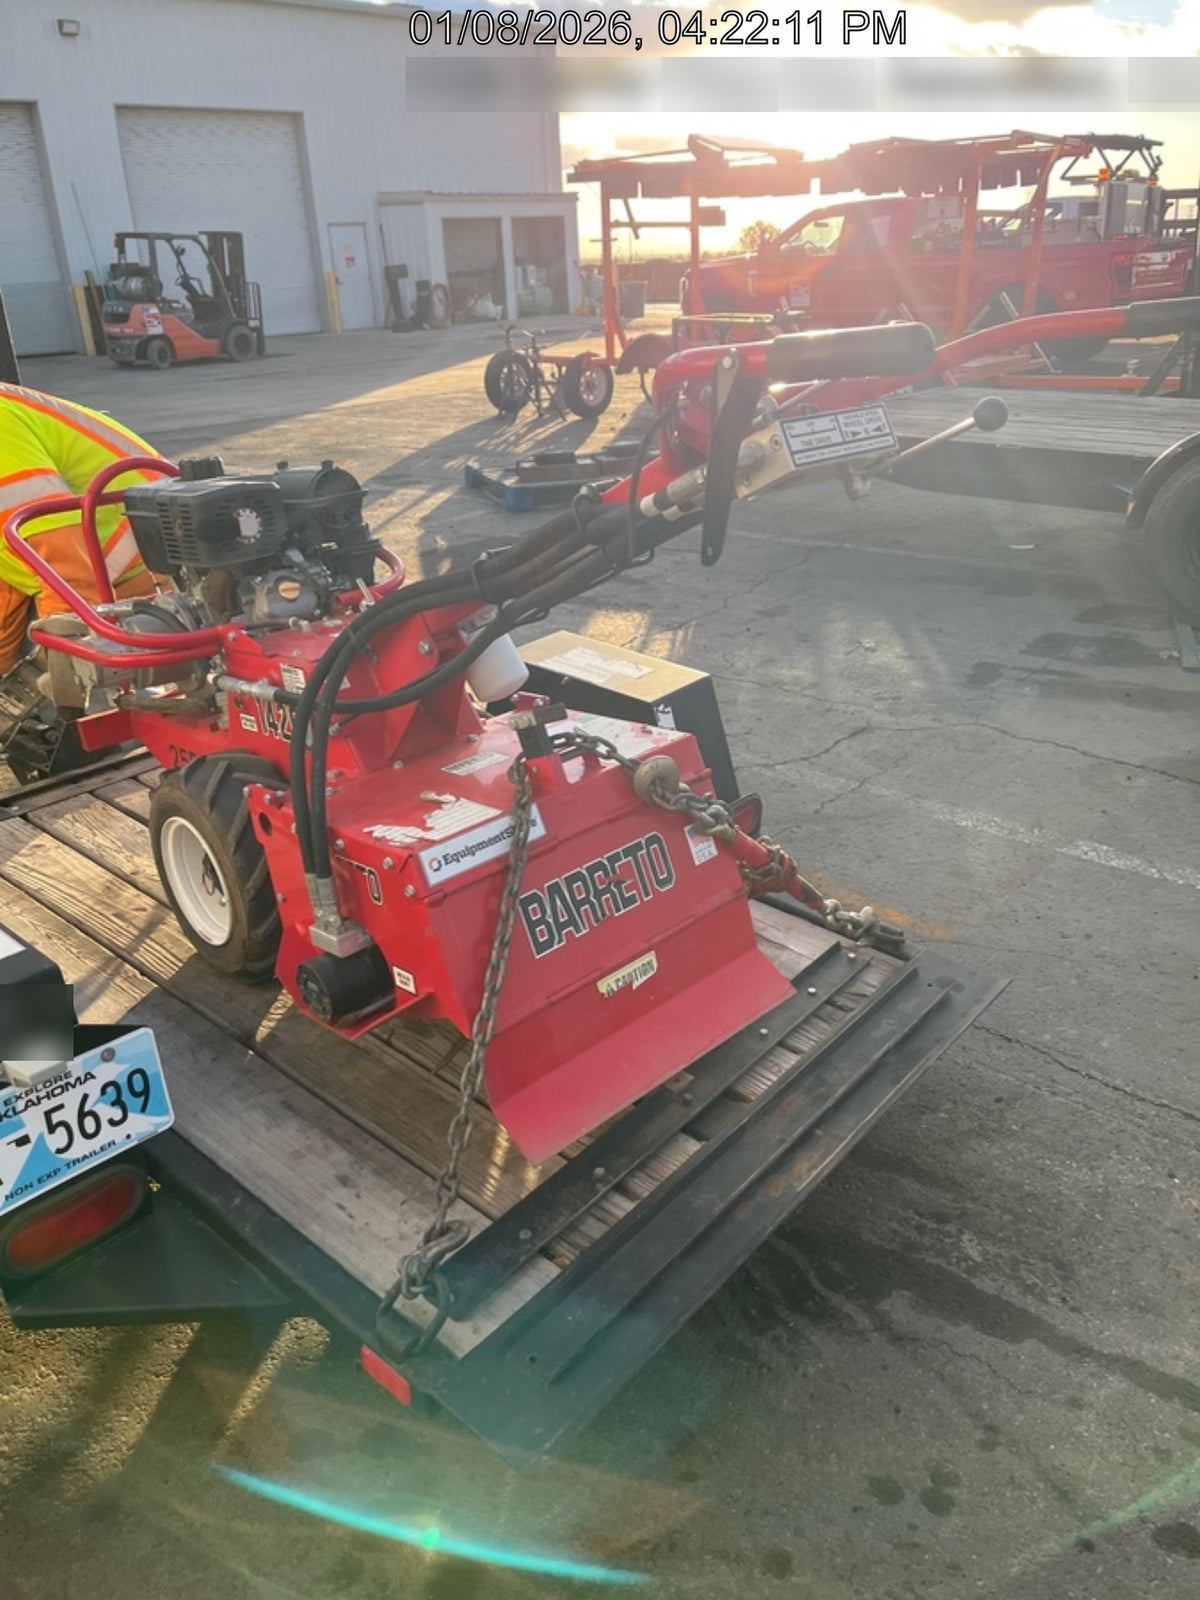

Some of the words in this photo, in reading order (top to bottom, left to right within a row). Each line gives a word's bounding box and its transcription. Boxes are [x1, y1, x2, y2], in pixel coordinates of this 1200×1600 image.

[441, 819, 538, 867] EquipmentSe
[517, 831, 676, 960] BARRETO
[0, 1071, 97, 1123] KLAHOMA
[3, 1070, 74, 1107] EXPLORE
[43, 1067, 150, 1155] 5639
[5, 1181, 34, 1202] NON
[37, 1167, 61, 1184] EXP
[64, 1139, 117, 1171] TRAILER
